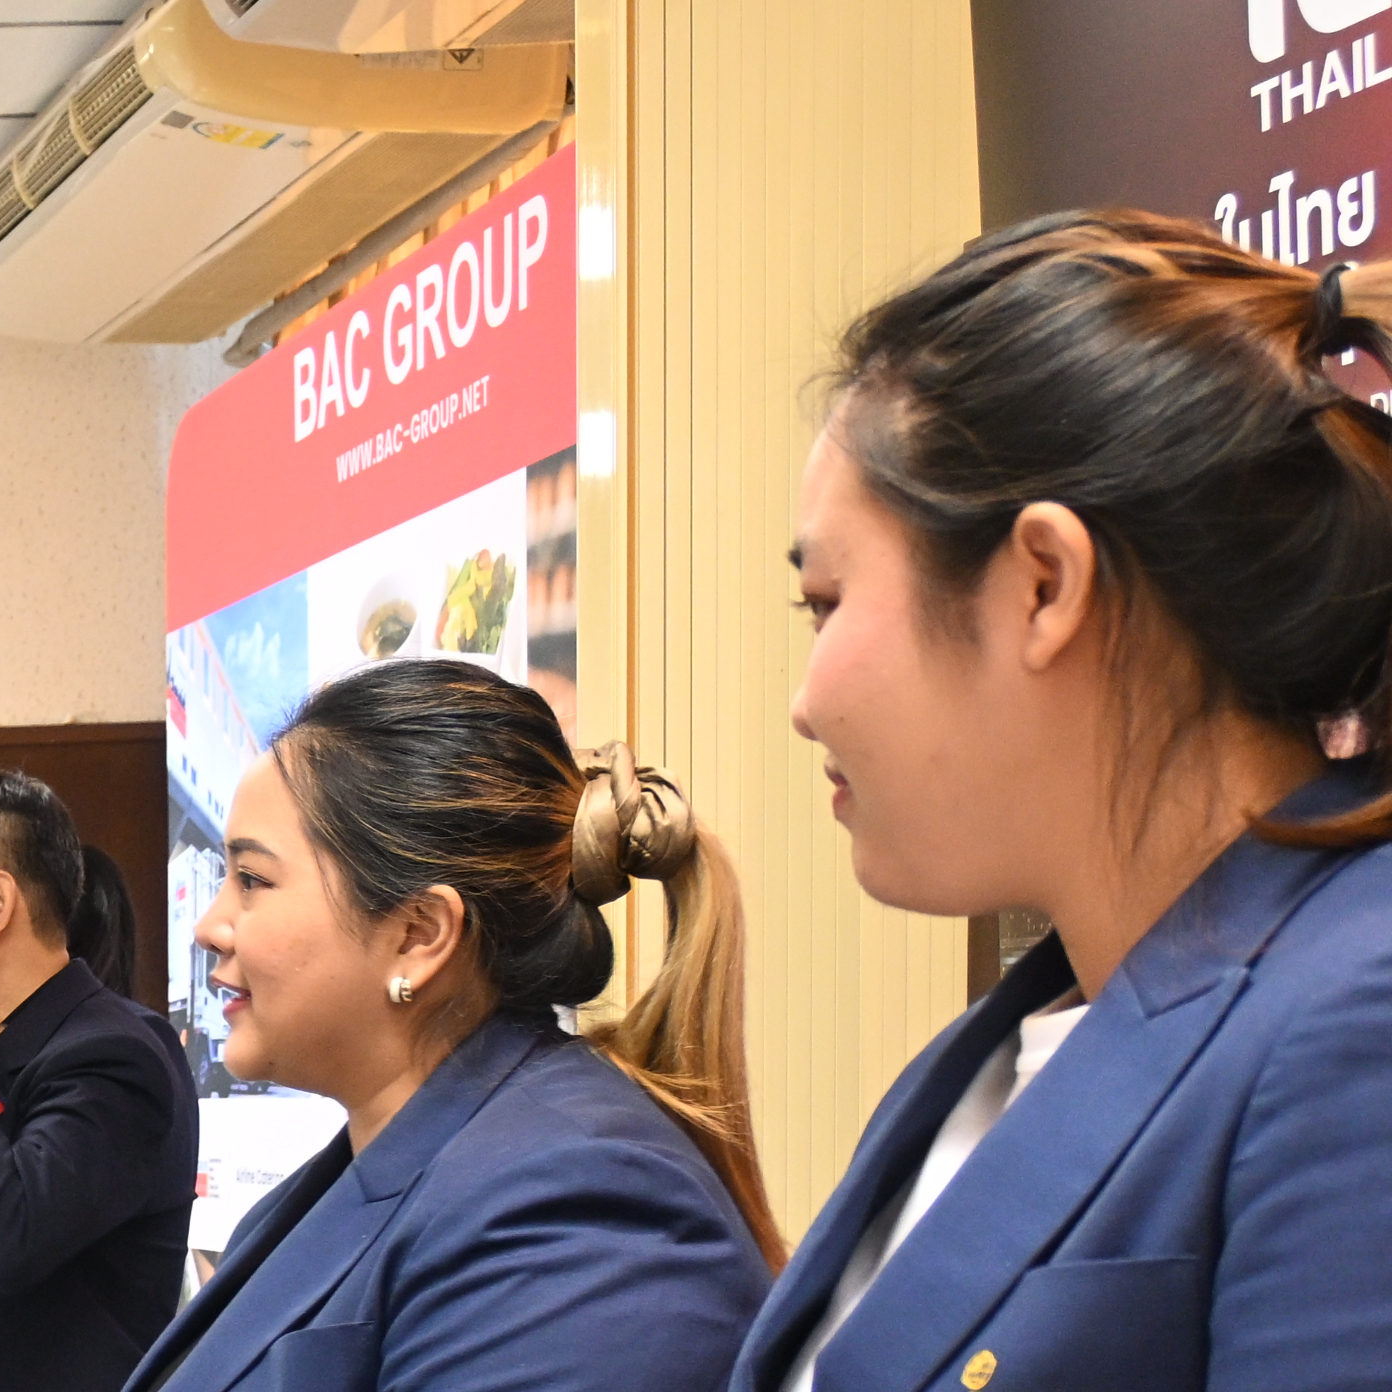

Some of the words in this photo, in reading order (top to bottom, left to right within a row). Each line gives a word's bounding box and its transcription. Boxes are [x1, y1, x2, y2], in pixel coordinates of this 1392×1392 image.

[293, 310, 371, 443] BAC
[382, 194, 549, 386] GROUP
[335, 374, 491, 484] WWW.BAC-GROUP.NET
